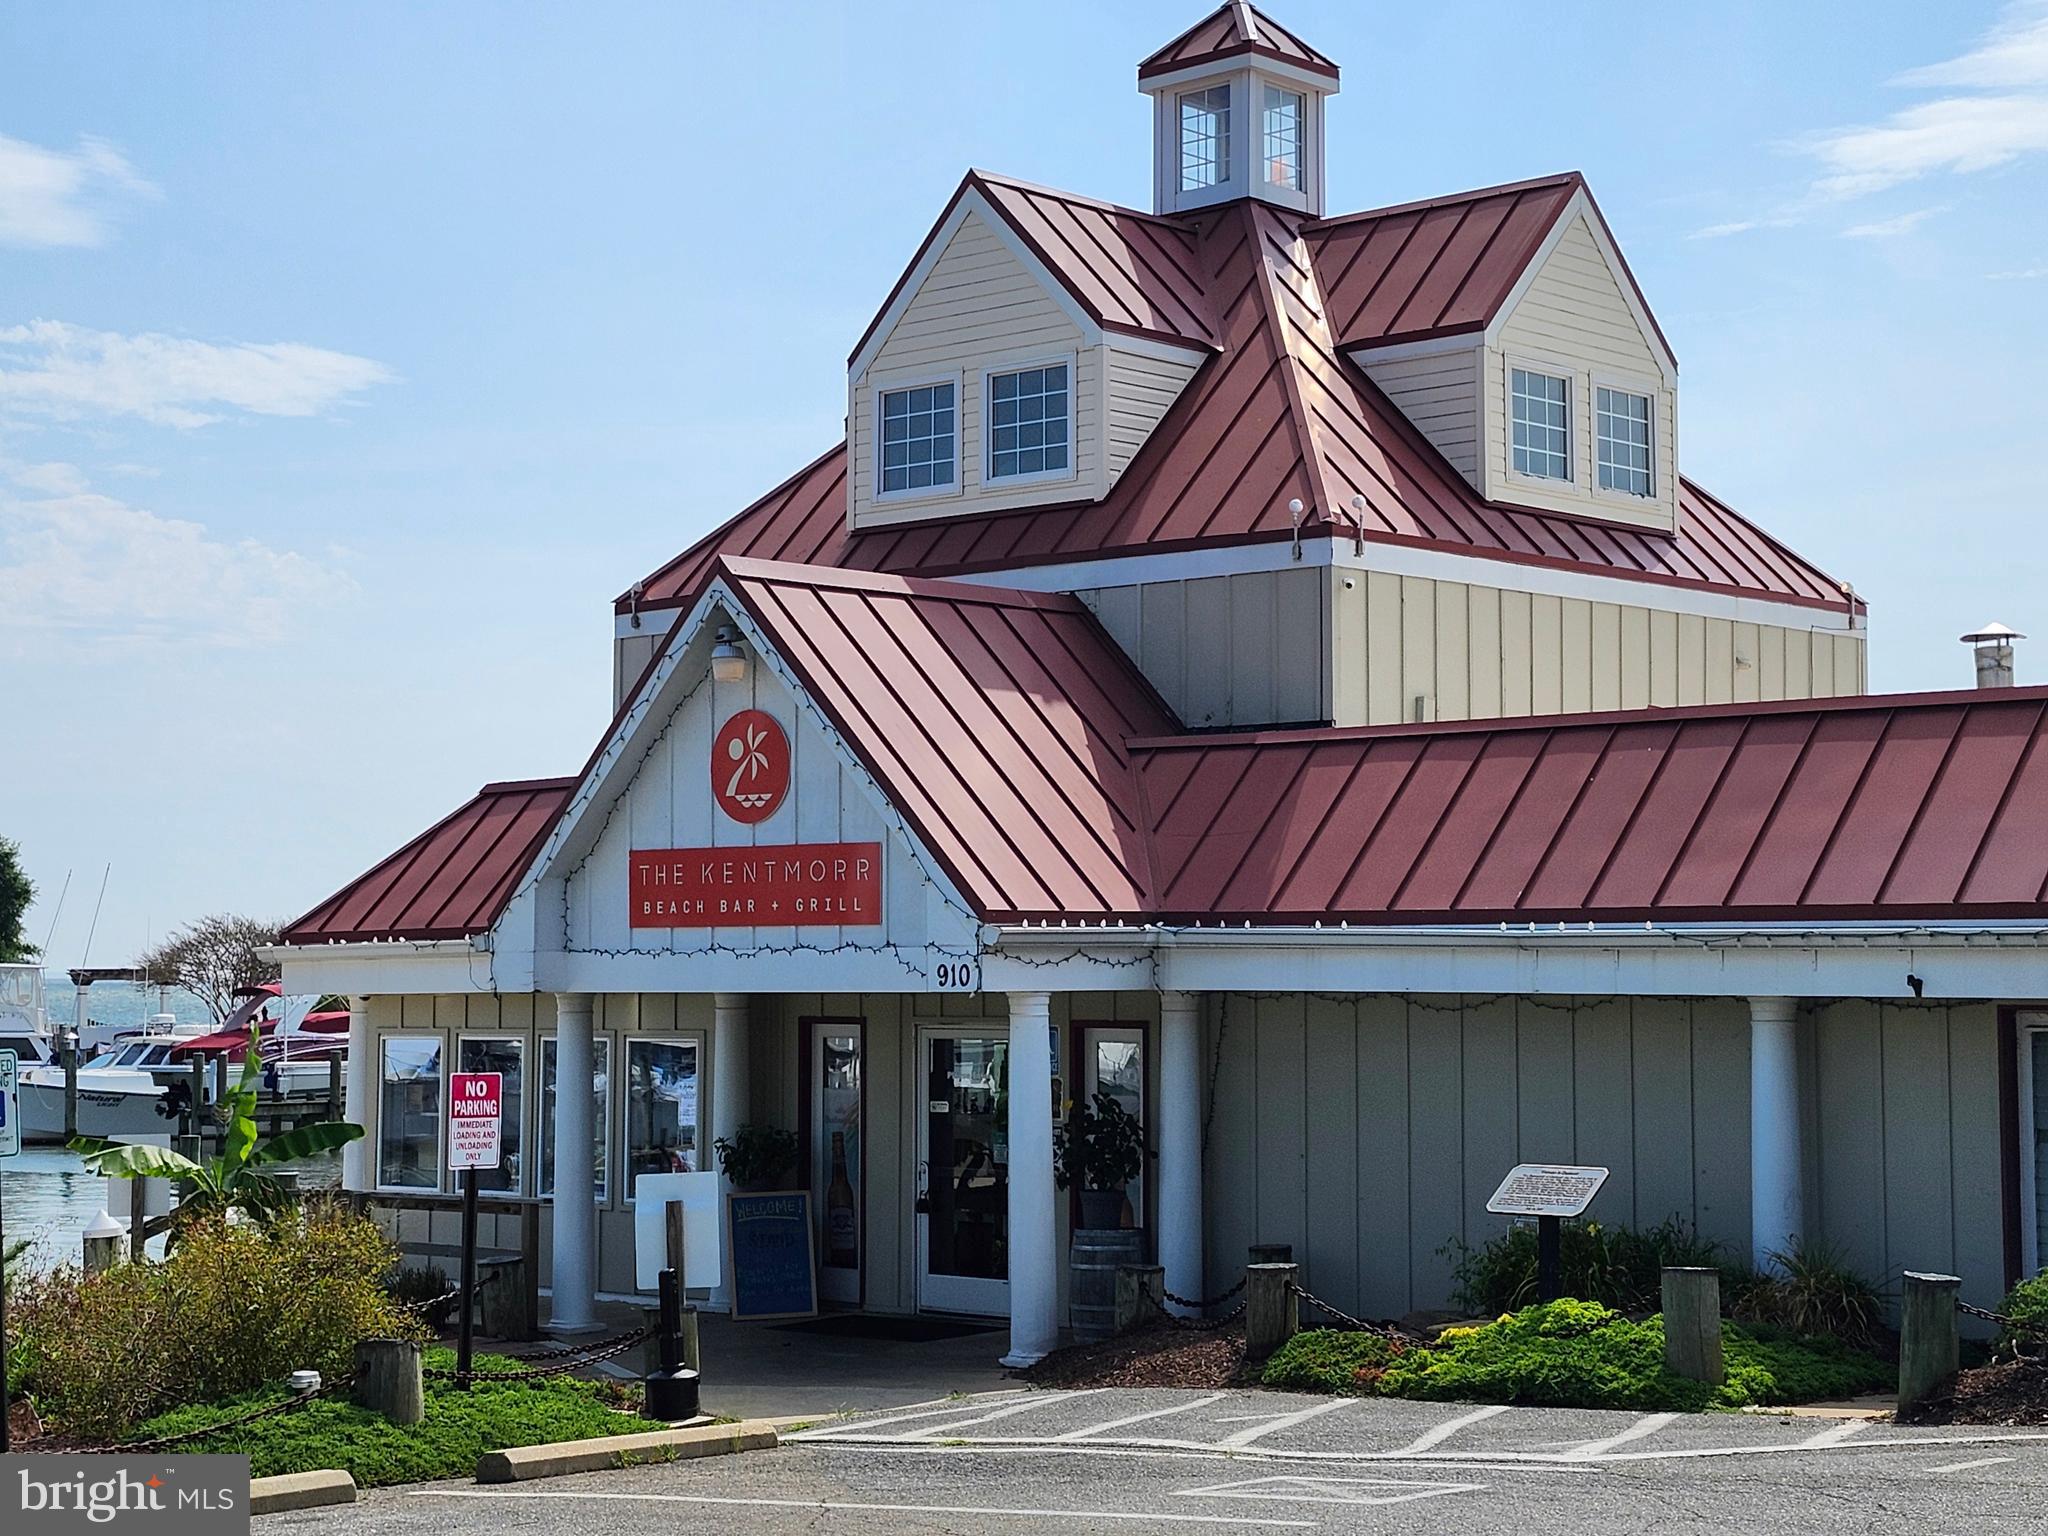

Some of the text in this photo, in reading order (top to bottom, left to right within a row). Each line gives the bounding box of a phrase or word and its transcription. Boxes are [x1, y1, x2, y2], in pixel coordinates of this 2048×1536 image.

[639, 858, 870, 886] THE KENTMORR
[643, 900, 704, 915] BEACH
[720, 899, 756, 913] BAR
[795, 897, 862, 912] GRILL
[936, 963, 971, 987] 910
[465, 1081, 488, 1097] NO
[454, 1099, 498, 1116] PARKING
[457, 1120, 493, 1129] IMMEDIATE
[453, 1131, 496, 1140] LOADING AND
[455, 1142, 493, 1150] UNLOADING
[465, 1153, 481, 1161] ONLY
